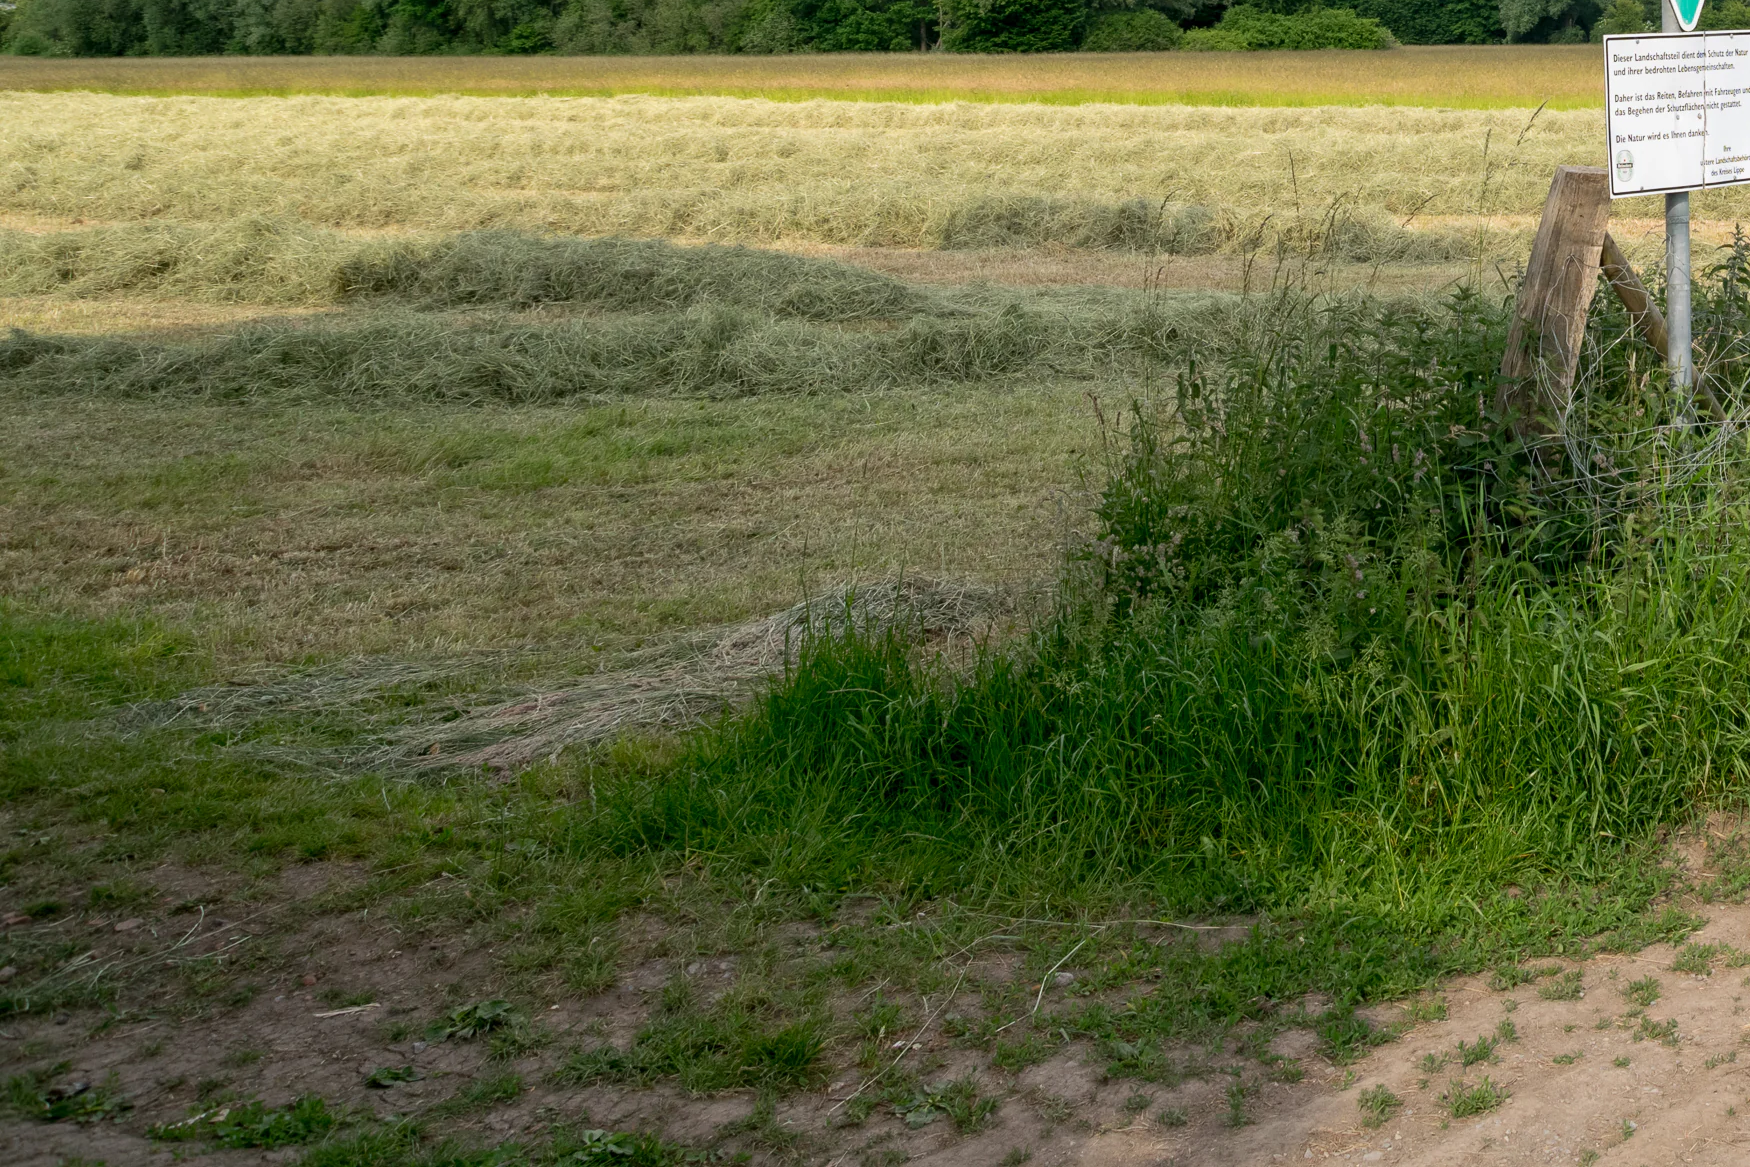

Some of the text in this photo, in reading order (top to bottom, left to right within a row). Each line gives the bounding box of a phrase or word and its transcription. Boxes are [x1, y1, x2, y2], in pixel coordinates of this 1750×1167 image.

[1613, 53, 1633, 63] Dieser
[1634, 51, 1680, 62] Landschaftsteil
[1681, 50, 1696, 60] dient
[1707, 49, 1725, 58] Schutz
[1725, 48, 1734, 57] der
[1734, 48, 1748, 56] Natur
[1613, 62, 1735, 76] und ihrer bedrohten Lebensgemeinschaften.
[1614, 93, 1633, 103] Daher
[1634, 92, 1643, 102] ist
[1644, 92, 1656, 101] das
[1656, 90, 1677, 100] Reiten,
[1677, 89, 1703, 99] Befahren
[1714, 86, 1742, 98] Fahrzeugen
[1614, 100, 1742, 117] das Begehen der Schutzflächen nicht gestattet.
[1615, 134, 1627, 144] Die
[1627, 133, 1646, 143] Natur
[1646, 131, 1662, 141] wird
[1662, 132, 1670, 140] es
[1670, 130, 1687, 139] Ihnen
